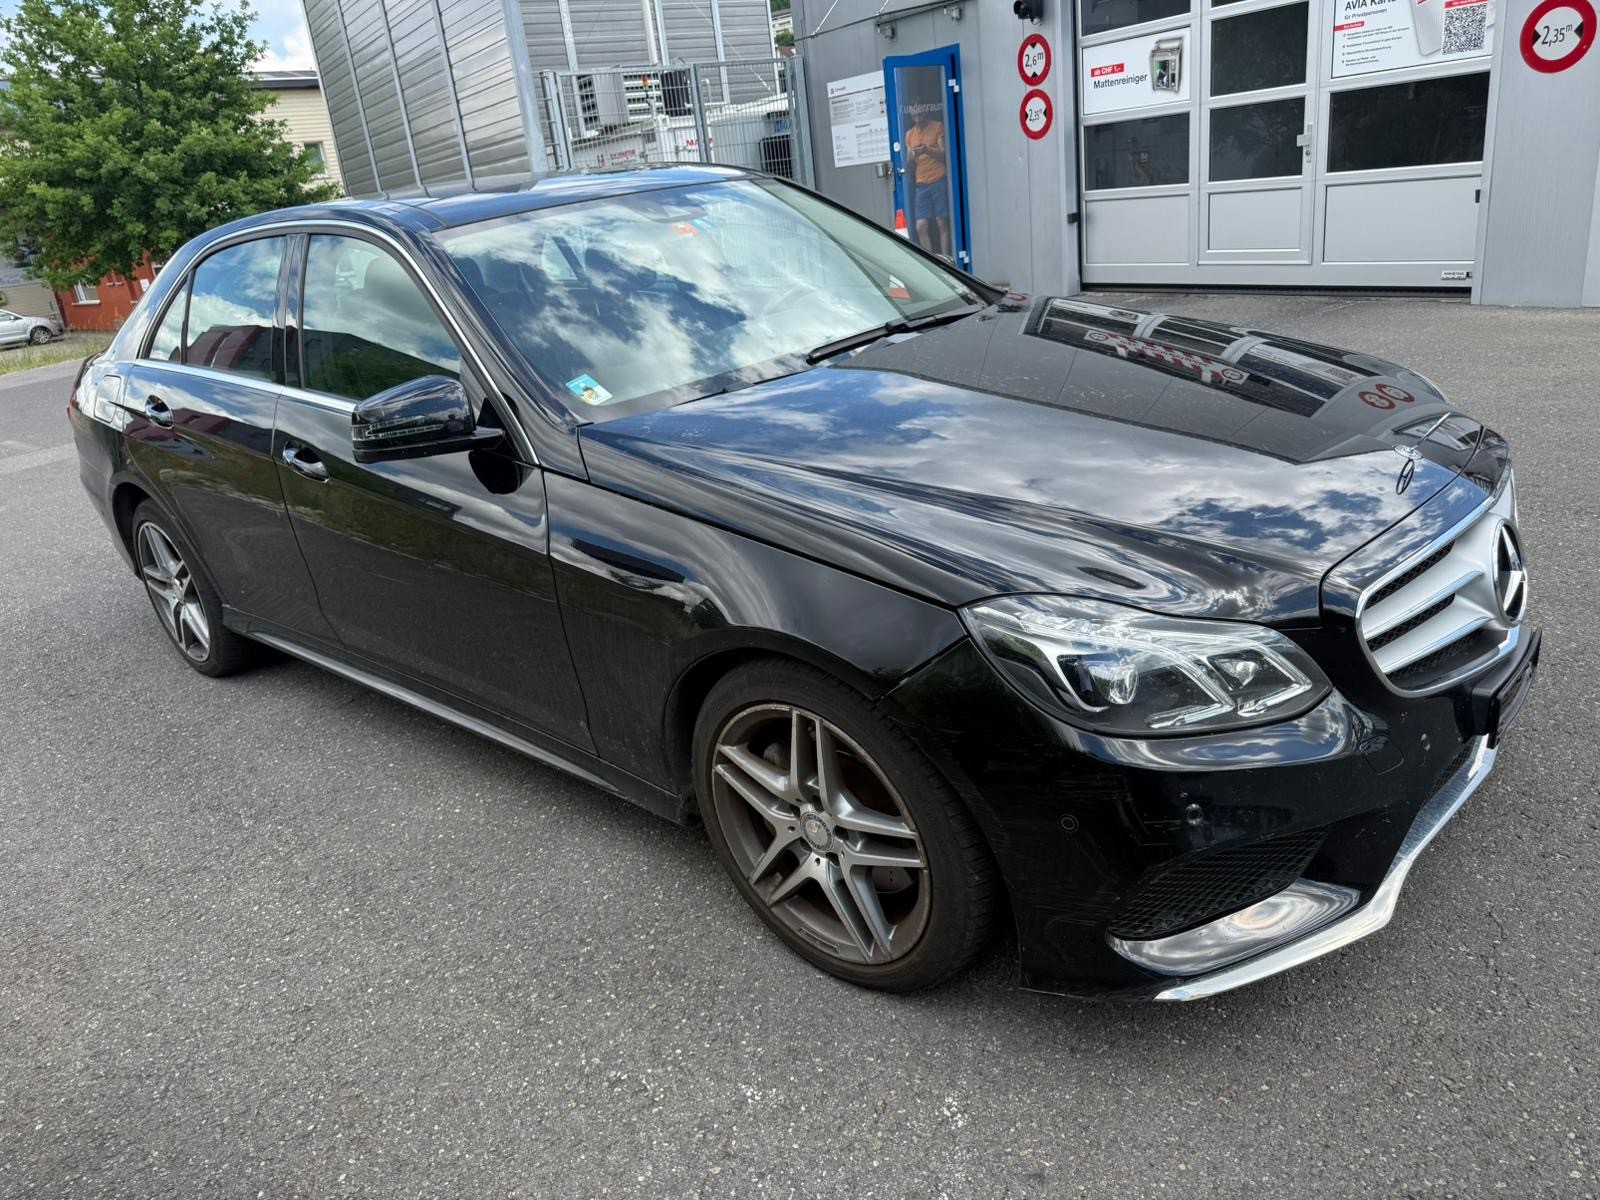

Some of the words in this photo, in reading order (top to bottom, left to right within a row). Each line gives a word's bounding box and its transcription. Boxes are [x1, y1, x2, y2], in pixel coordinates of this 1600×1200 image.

[1345, 0, 1368, 11] AVIA
[1101, 65, 1113, 75] CHF
[1093, 74, 1148, 89] Mattenreiniger
